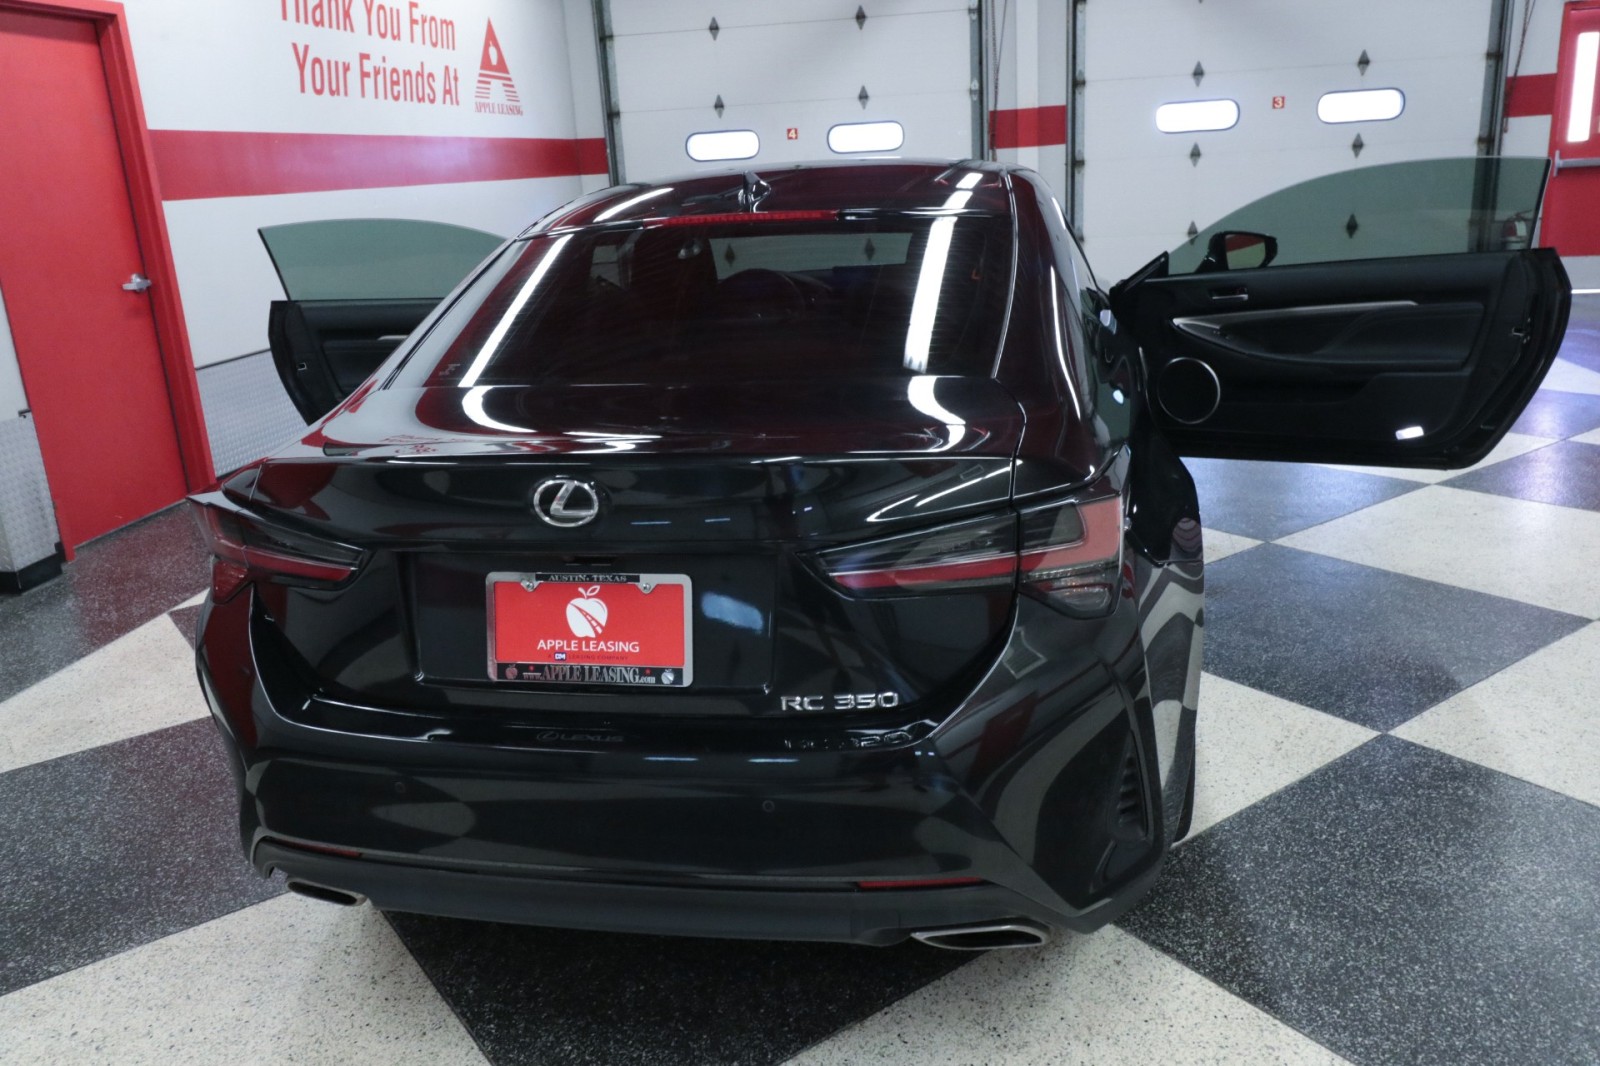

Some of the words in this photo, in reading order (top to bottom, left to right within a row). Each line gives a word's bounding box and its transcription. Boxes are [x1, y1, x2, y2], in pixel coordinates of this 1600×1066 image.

[363, 0, 401, 41] You
[409, 1, 456, 51] From
[291, 42, 350, 97] Your
[359, 52, 436, 104] Friends
[442, 65, 460, 106] At
[474, 101, 496, 114] APPLE
[1274, 96, 1283, 108] 3
[788, 128, 797, 140] 4
[592, 574, 628, 582] TEXAS
[537, 640, 579, 651] APPLE
[581, 641, 640, 653] LEASING
[780, 695, 824, 711] RC
[834, 691, 899, 709] 350
